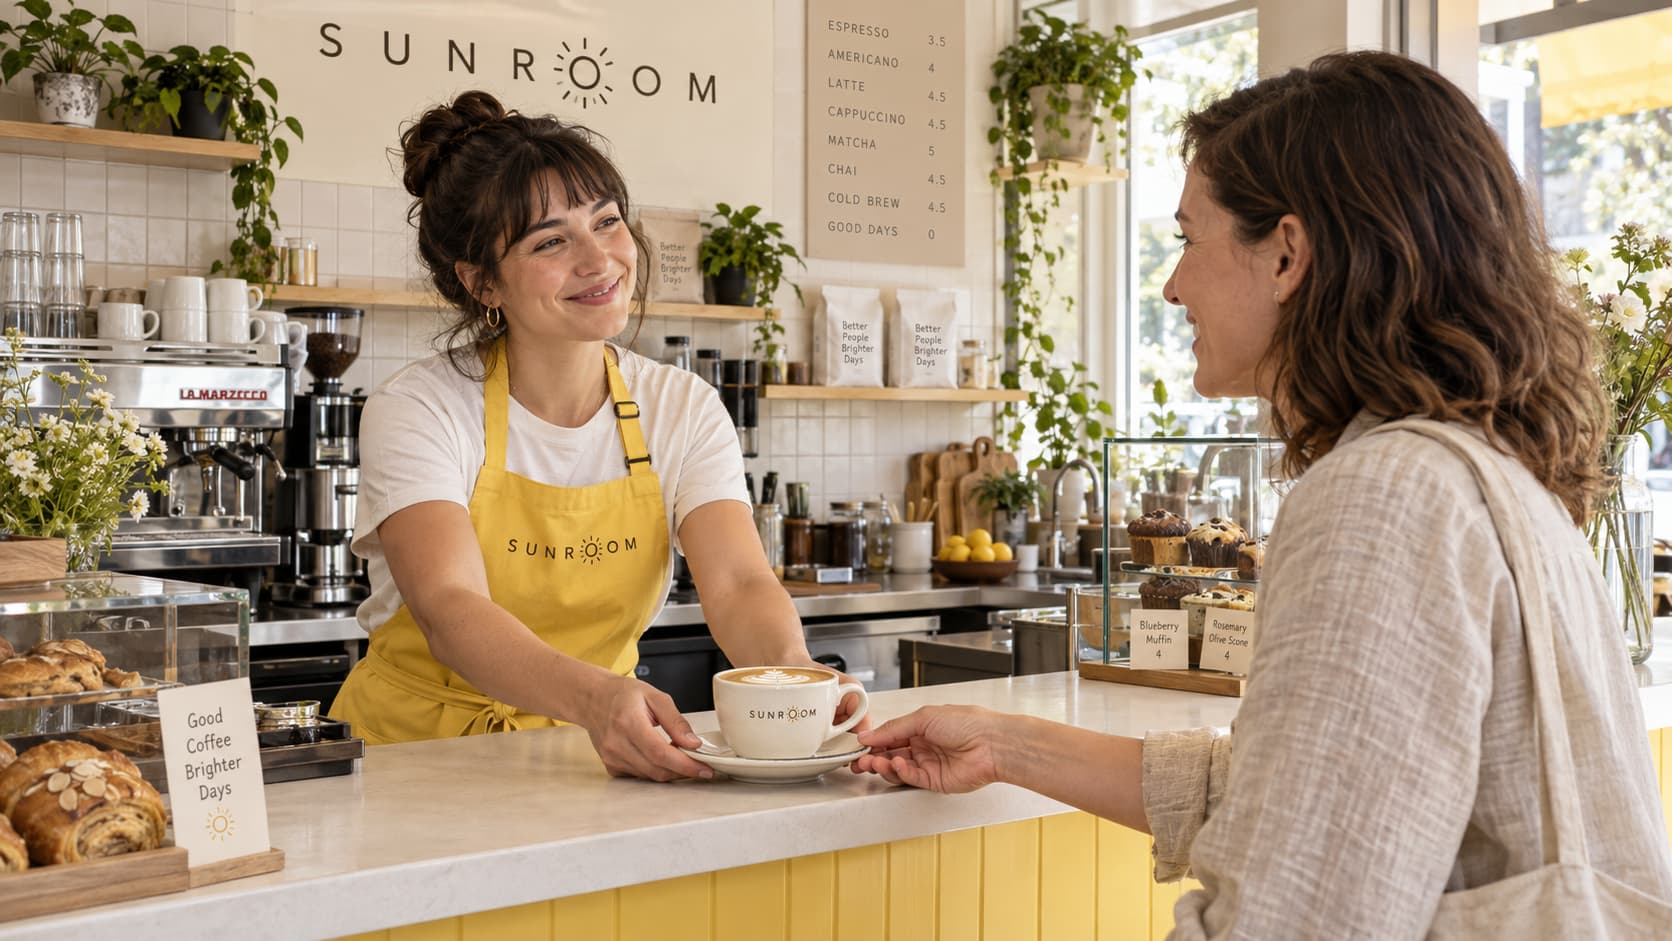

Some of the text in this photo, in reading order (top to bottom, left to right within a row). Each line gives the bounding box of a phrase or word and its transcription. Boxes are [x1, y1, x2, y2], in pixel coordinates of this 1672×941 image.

[828, 19, 946, 47] ESPRESSO 3.5
[319, 22, 717, 109] SUNROOM
[828, 48, 935, 73] AMERICANO 4
[828, 77, 946, 103] LATTE 4.5
[828, 105, 946, 130] CAPPUCCINO 4.5
[828, 134, 935, 156] MATCHA 5
[828, 163, 946, 186] CHAI 4.5
[828, 191, 946, 214] COLD BREW 4.5
[828, 220, 935, 240] GOOD DAYS 0
[842, 321, 868, 331] Better
[915, 323, 942, 334] Better
[842, 332, 869, 344] People
[915, 335, 942, 346] People
[841, 343, 875, 355] Brighter
[914, 346, 948, 358] Brighter
[844, 354, 864, 367] Days
[916, 357, 936, 368] Days
[180, 387, 195, 400] LA
[507, 536, 637, 563] SUNROOM
[1139, 620, 1179, 633] Blueberry
[1213, 619, 1248, 634] Rosemary
[1146, 635, 1172, 645] Muffin
[1228, 635, 1249, 647] Scone
[1155, 649, 1162, 659] 4
[1224, 650, 1231, 661] 4
[187, 706, 223, 729] Good
[749, 707, 817, 721] SUNROOM
[186, 733, 232, 754] Coffee
[185, 757, 242, 780] Brighter
[199, 783, 232, 801] Days
